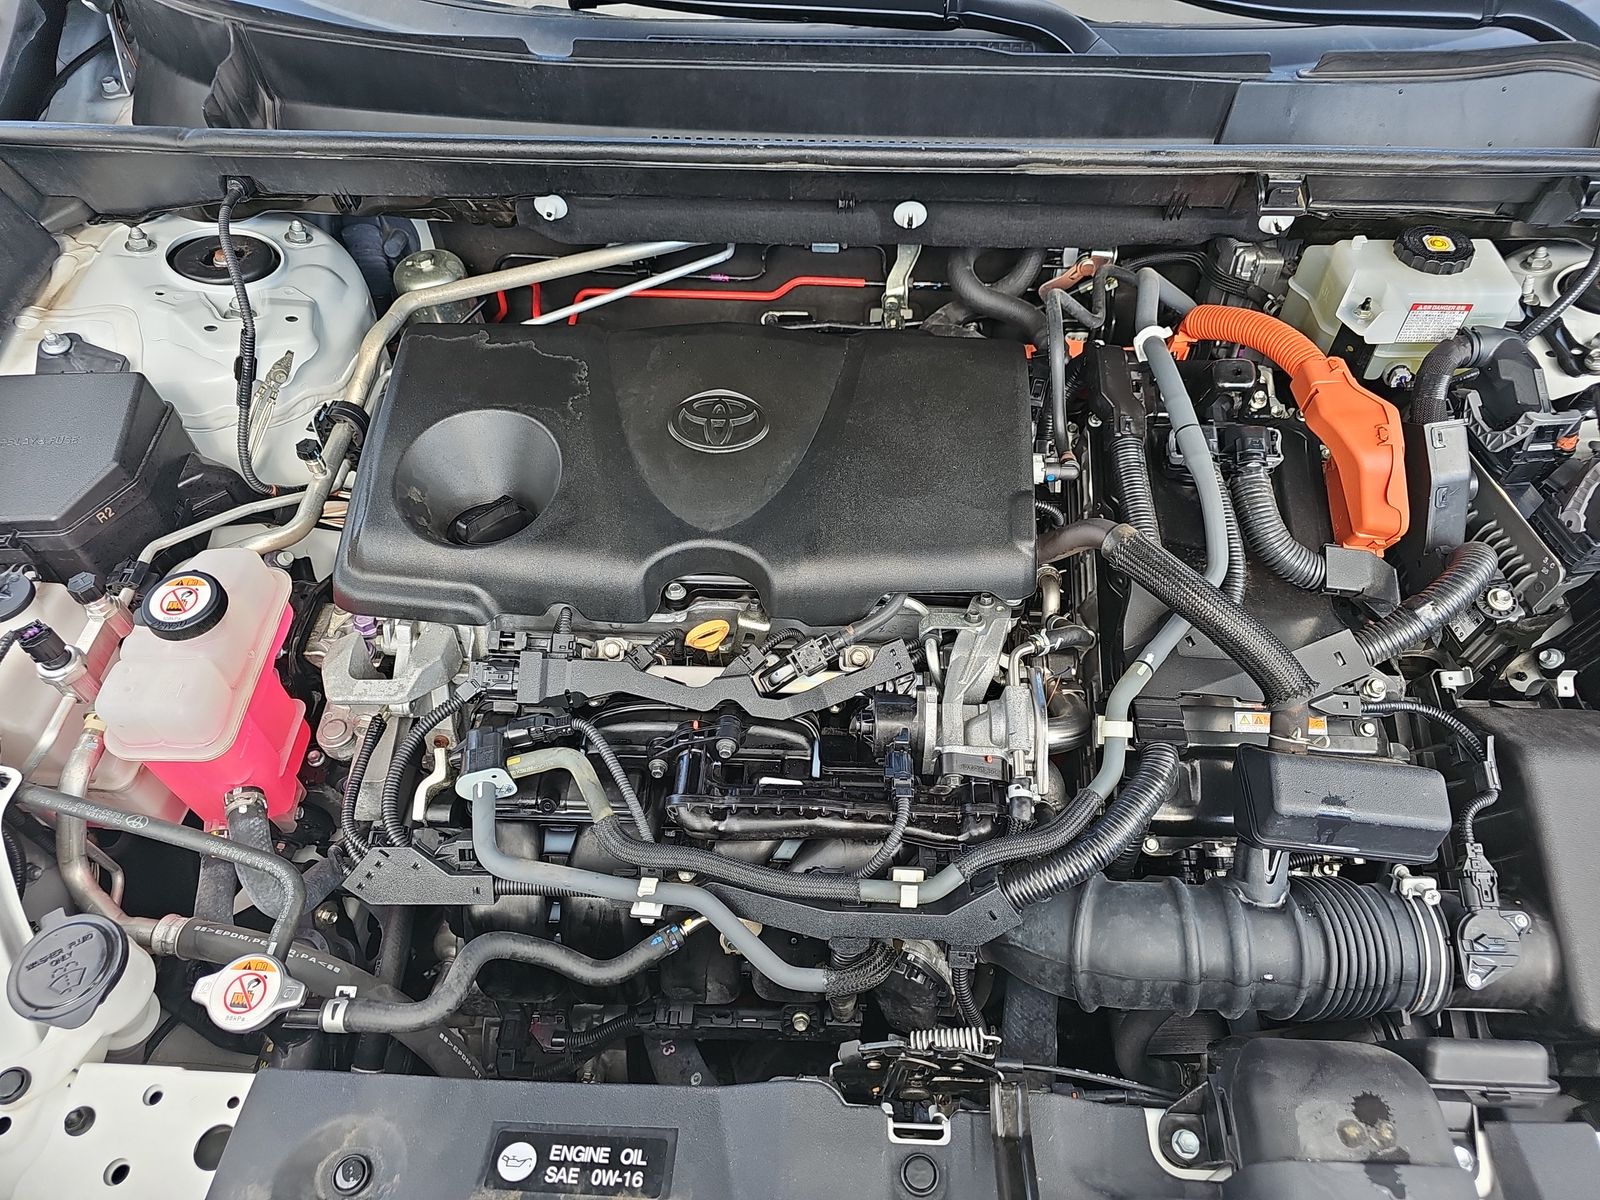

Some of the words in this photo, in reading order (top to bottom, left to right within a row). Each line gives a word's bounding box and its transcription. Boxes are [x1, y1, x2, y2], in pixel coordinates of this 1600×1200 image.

[95, 507, 116, 524] R2
[549, 1144, 612, 1164] ENGINE
[620, 1147, 648, 1166] OIL
[544, 1166, 581, 1184] SAE
[591, 1170, 645, 1188] 0W-16
